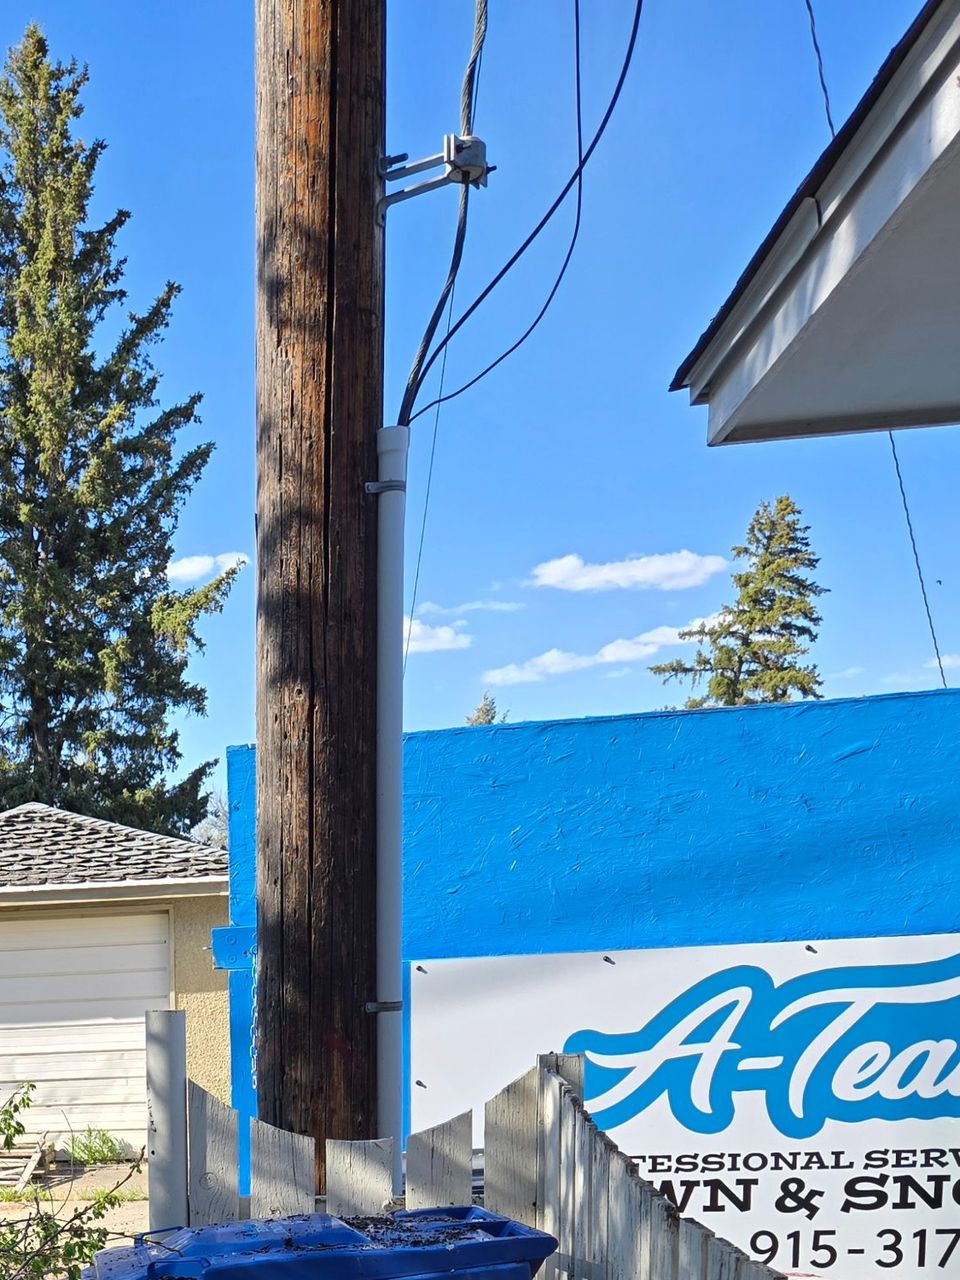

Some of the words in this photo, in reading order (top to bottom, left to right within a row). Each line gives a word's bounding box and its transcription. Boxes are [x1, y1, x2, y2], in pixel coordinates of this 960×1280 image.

[580, 973, 960, 1118] A-Tea
[775, 1176, 826, 1221] &
[840, 1172, 960, 1214] SN
